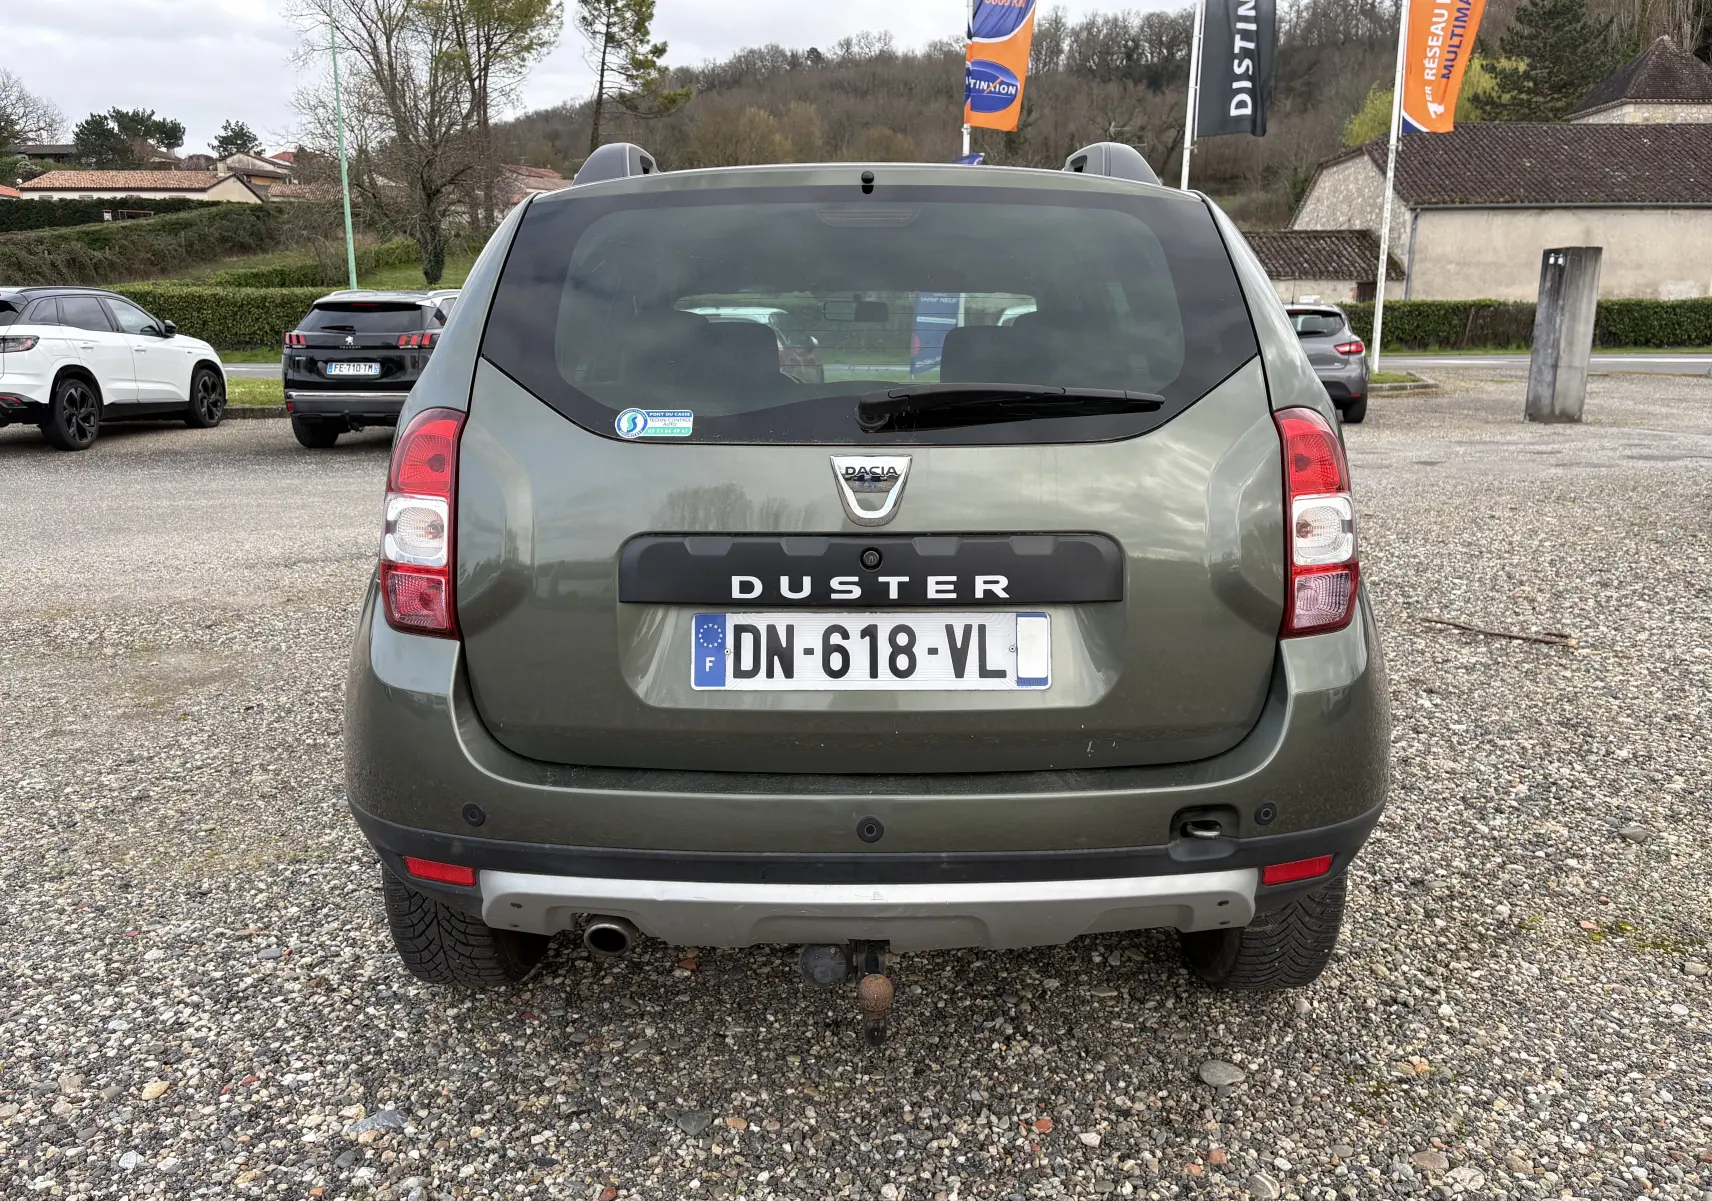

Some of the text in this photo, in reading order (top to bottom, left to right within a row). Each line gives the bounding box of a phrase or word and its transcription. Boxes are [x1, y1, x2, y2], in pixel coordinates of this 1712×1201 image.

[1423, 8, 1448, 80] RÉSEAU
[844, 466, 898, 476] DACIA
[731, 575, 1010, 600] DUSTER
[733, 623, 1007, 680] DN-618-VL
[705, 657, 715, 672] F
